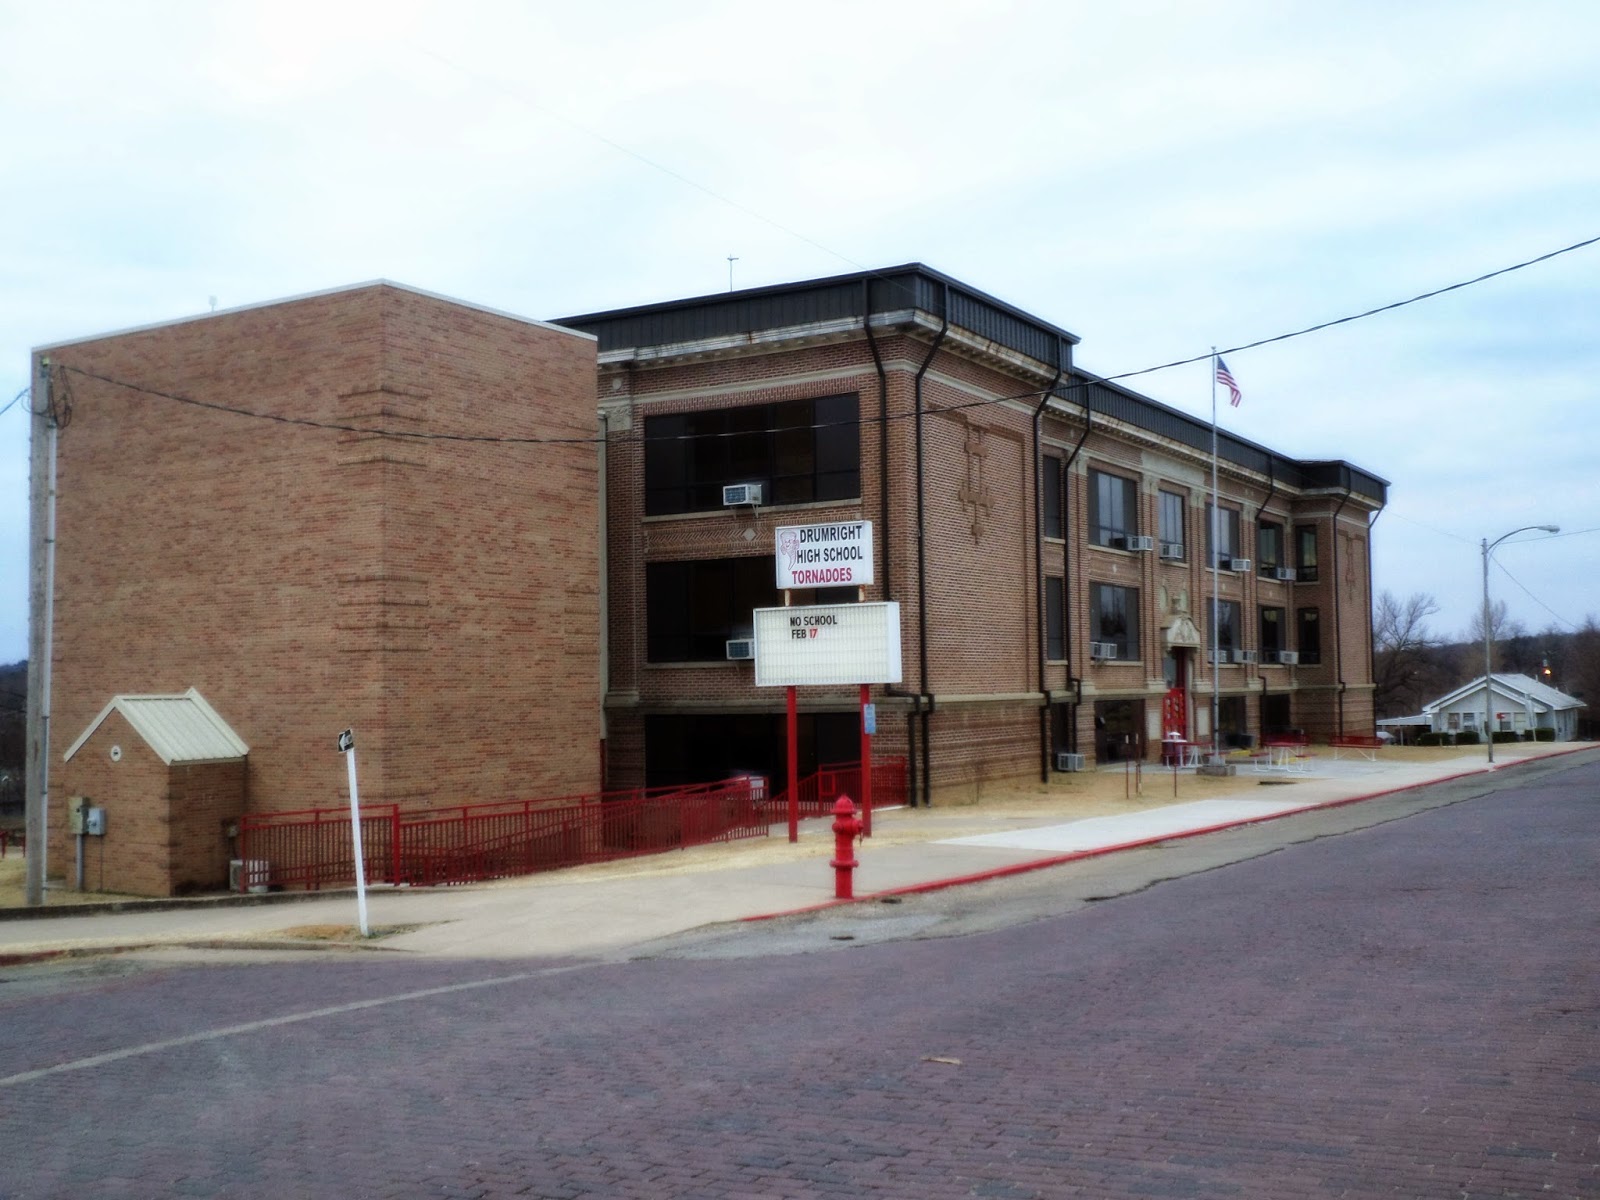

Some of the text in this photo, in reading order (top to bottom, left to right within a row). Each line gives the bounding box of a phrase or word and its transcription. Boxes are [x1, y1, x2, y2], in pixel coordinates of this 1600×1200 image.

[800, 525, 862, 543] DRUMRIGHT
[797, 546, 863, 564] HIGH SCHOOL
[792, 567, 852, 584] TORNADOES
[790, 615, 837, 626] NO SCHOOL
[791, 628, 818, 639] FEB 17
